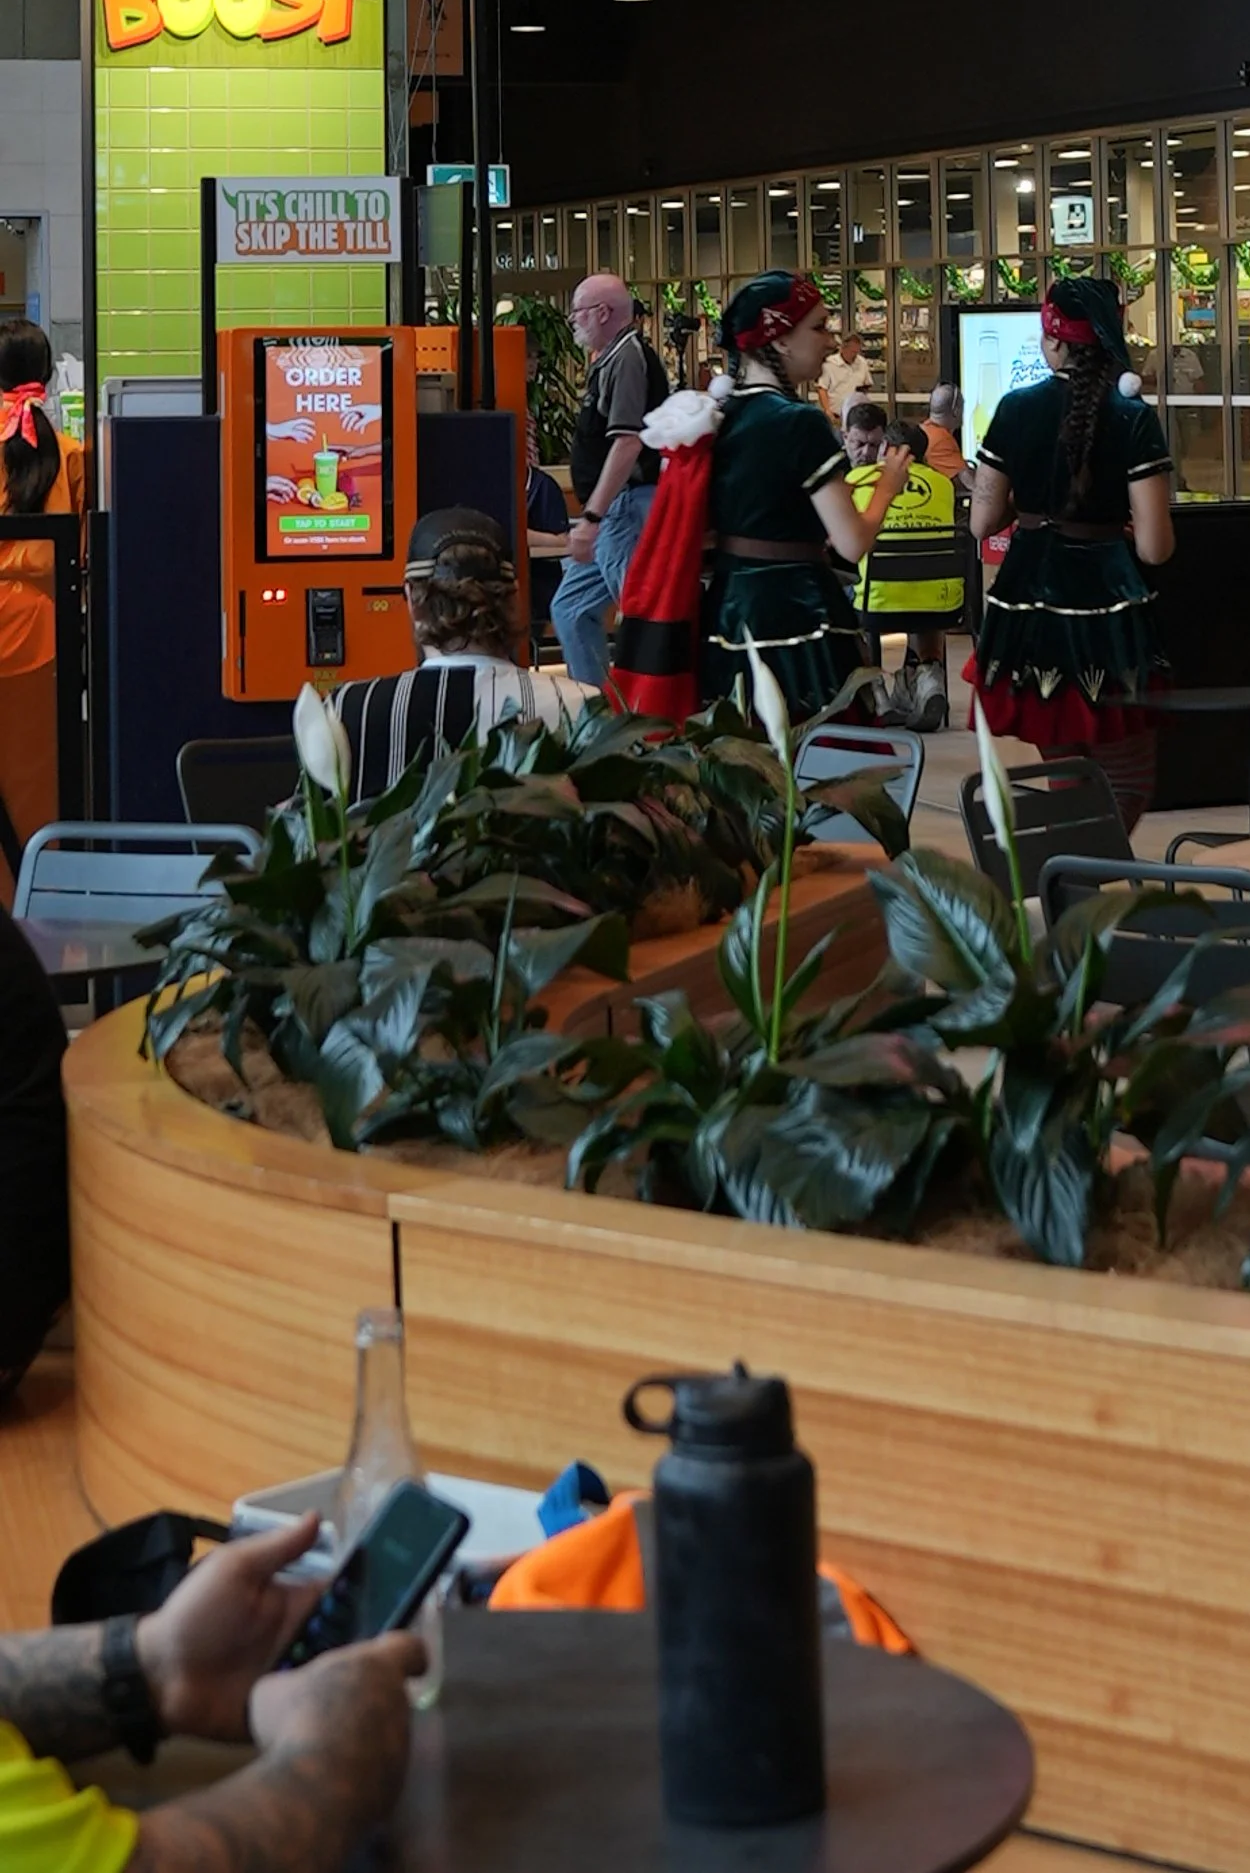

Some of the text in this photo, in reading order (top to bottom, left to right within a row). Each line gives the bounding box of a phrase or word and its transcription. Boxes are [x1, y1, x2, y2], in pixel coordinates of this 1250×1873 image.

[237, 191, 386, 222] IT'S CHILL TO
[237, 221, 390, 250] SKIP THE TILL
[285, 367, 362, 387] ORDER
[296, 393, 352, 413] HERE
